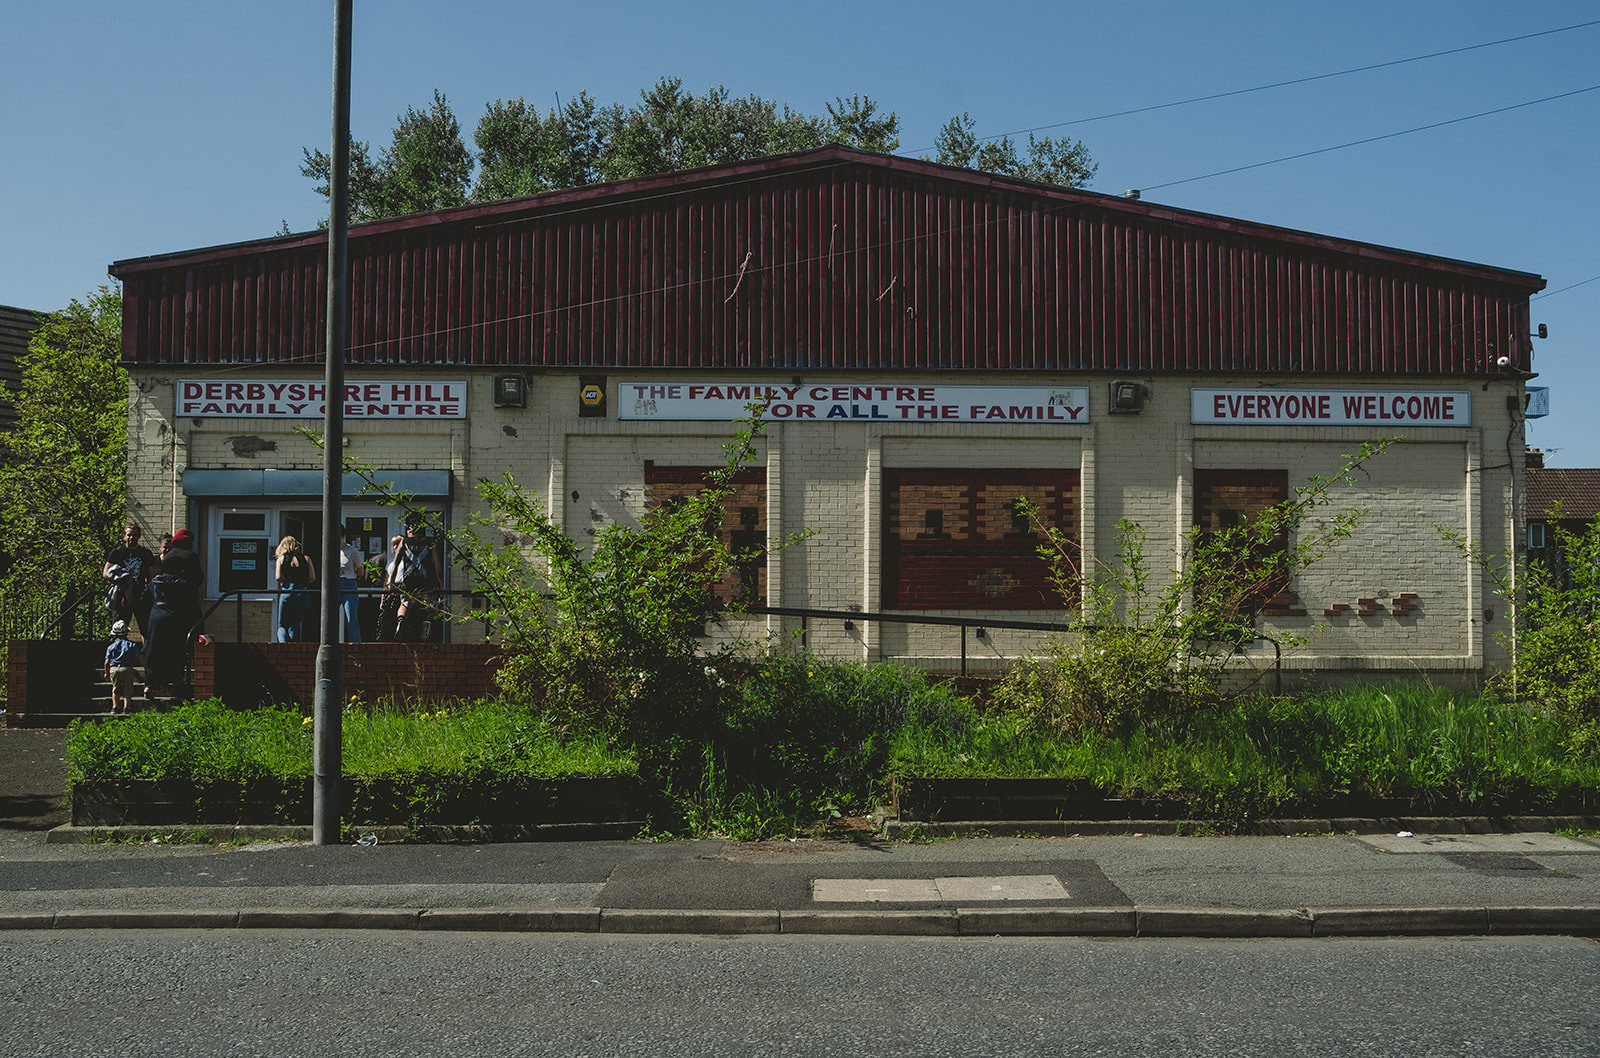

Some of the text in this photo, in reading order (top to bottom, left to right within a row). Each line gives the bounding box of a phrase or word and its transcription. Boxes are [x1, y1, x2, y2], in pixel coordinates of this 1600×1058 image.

[184, 383, 459, 402] DERBYSHRE HILL
[633, 386, 935, 401] THE FAMILY CENTRE
[184, 402, 459, 415] FAMILY ENTRE
[826, 404, 888, 418] ALL
[895, 405, 959, 419] THE
[970, 405, 1084, 419] FAMILY
[1213, 395, 1454, 419] EVERYONE WELCOME
